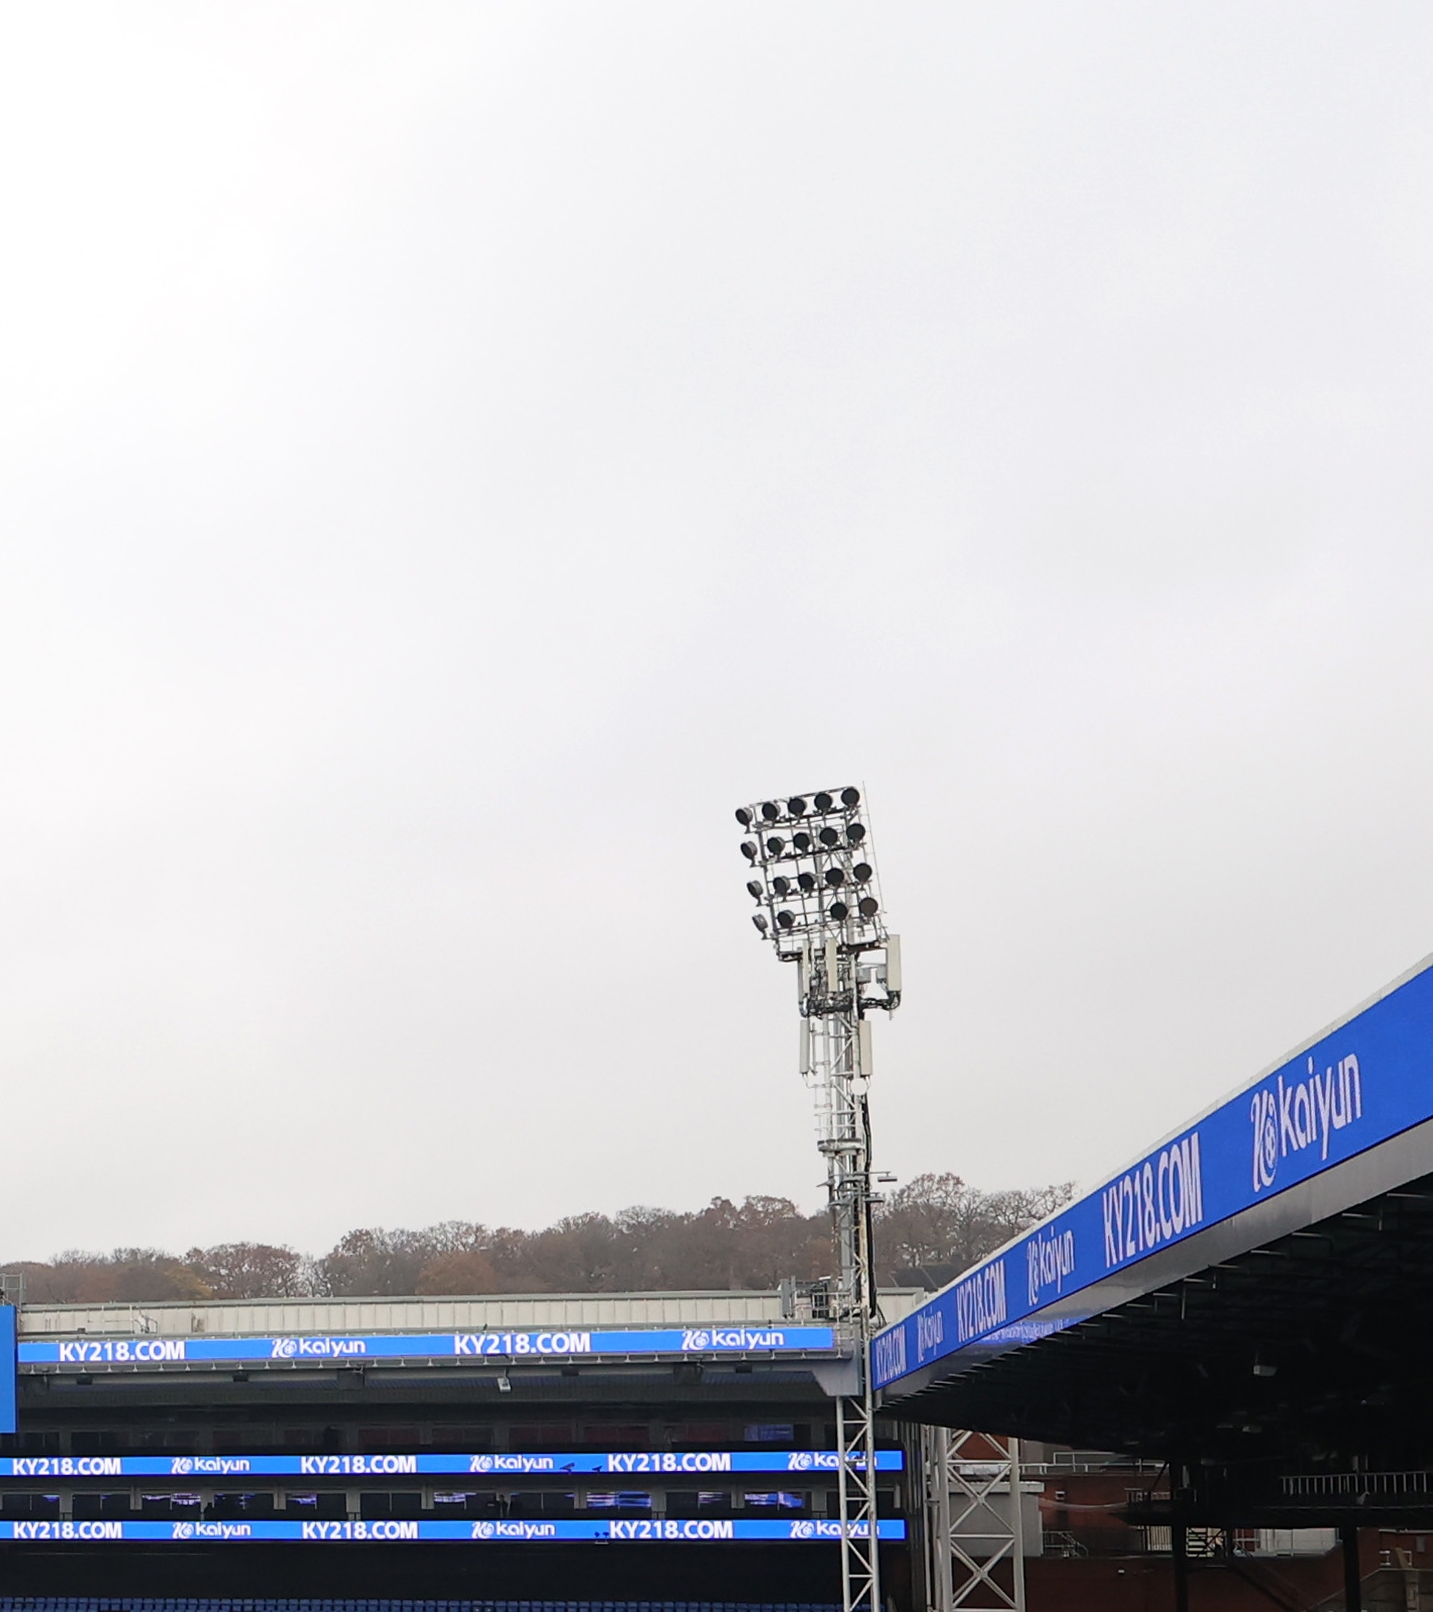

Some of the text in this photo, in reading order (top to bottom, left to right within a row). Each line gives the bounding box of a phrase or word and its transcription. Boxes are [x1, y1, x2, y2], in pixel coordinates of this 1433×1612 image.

[1103, 1131, 1203, 1268] KY218.COM
[956, 1259, 1007, 1343] KY218.COM
[59, 1340, 185, 1361] KY218.COM
[454, 1333, 590, 1354] KY218.COM
[13, 1458, 121, 1475] KY218.COM
[301, 1456, 416, 1473] KY218.COM
[608, 1453, 730, 1471] KY218.COM
[14, 1522, 122, 1539] KY218.COM
[303, 1521, 418, 1539] KY218.COM
[610, 1521, 733, 1538] KY218.COM
